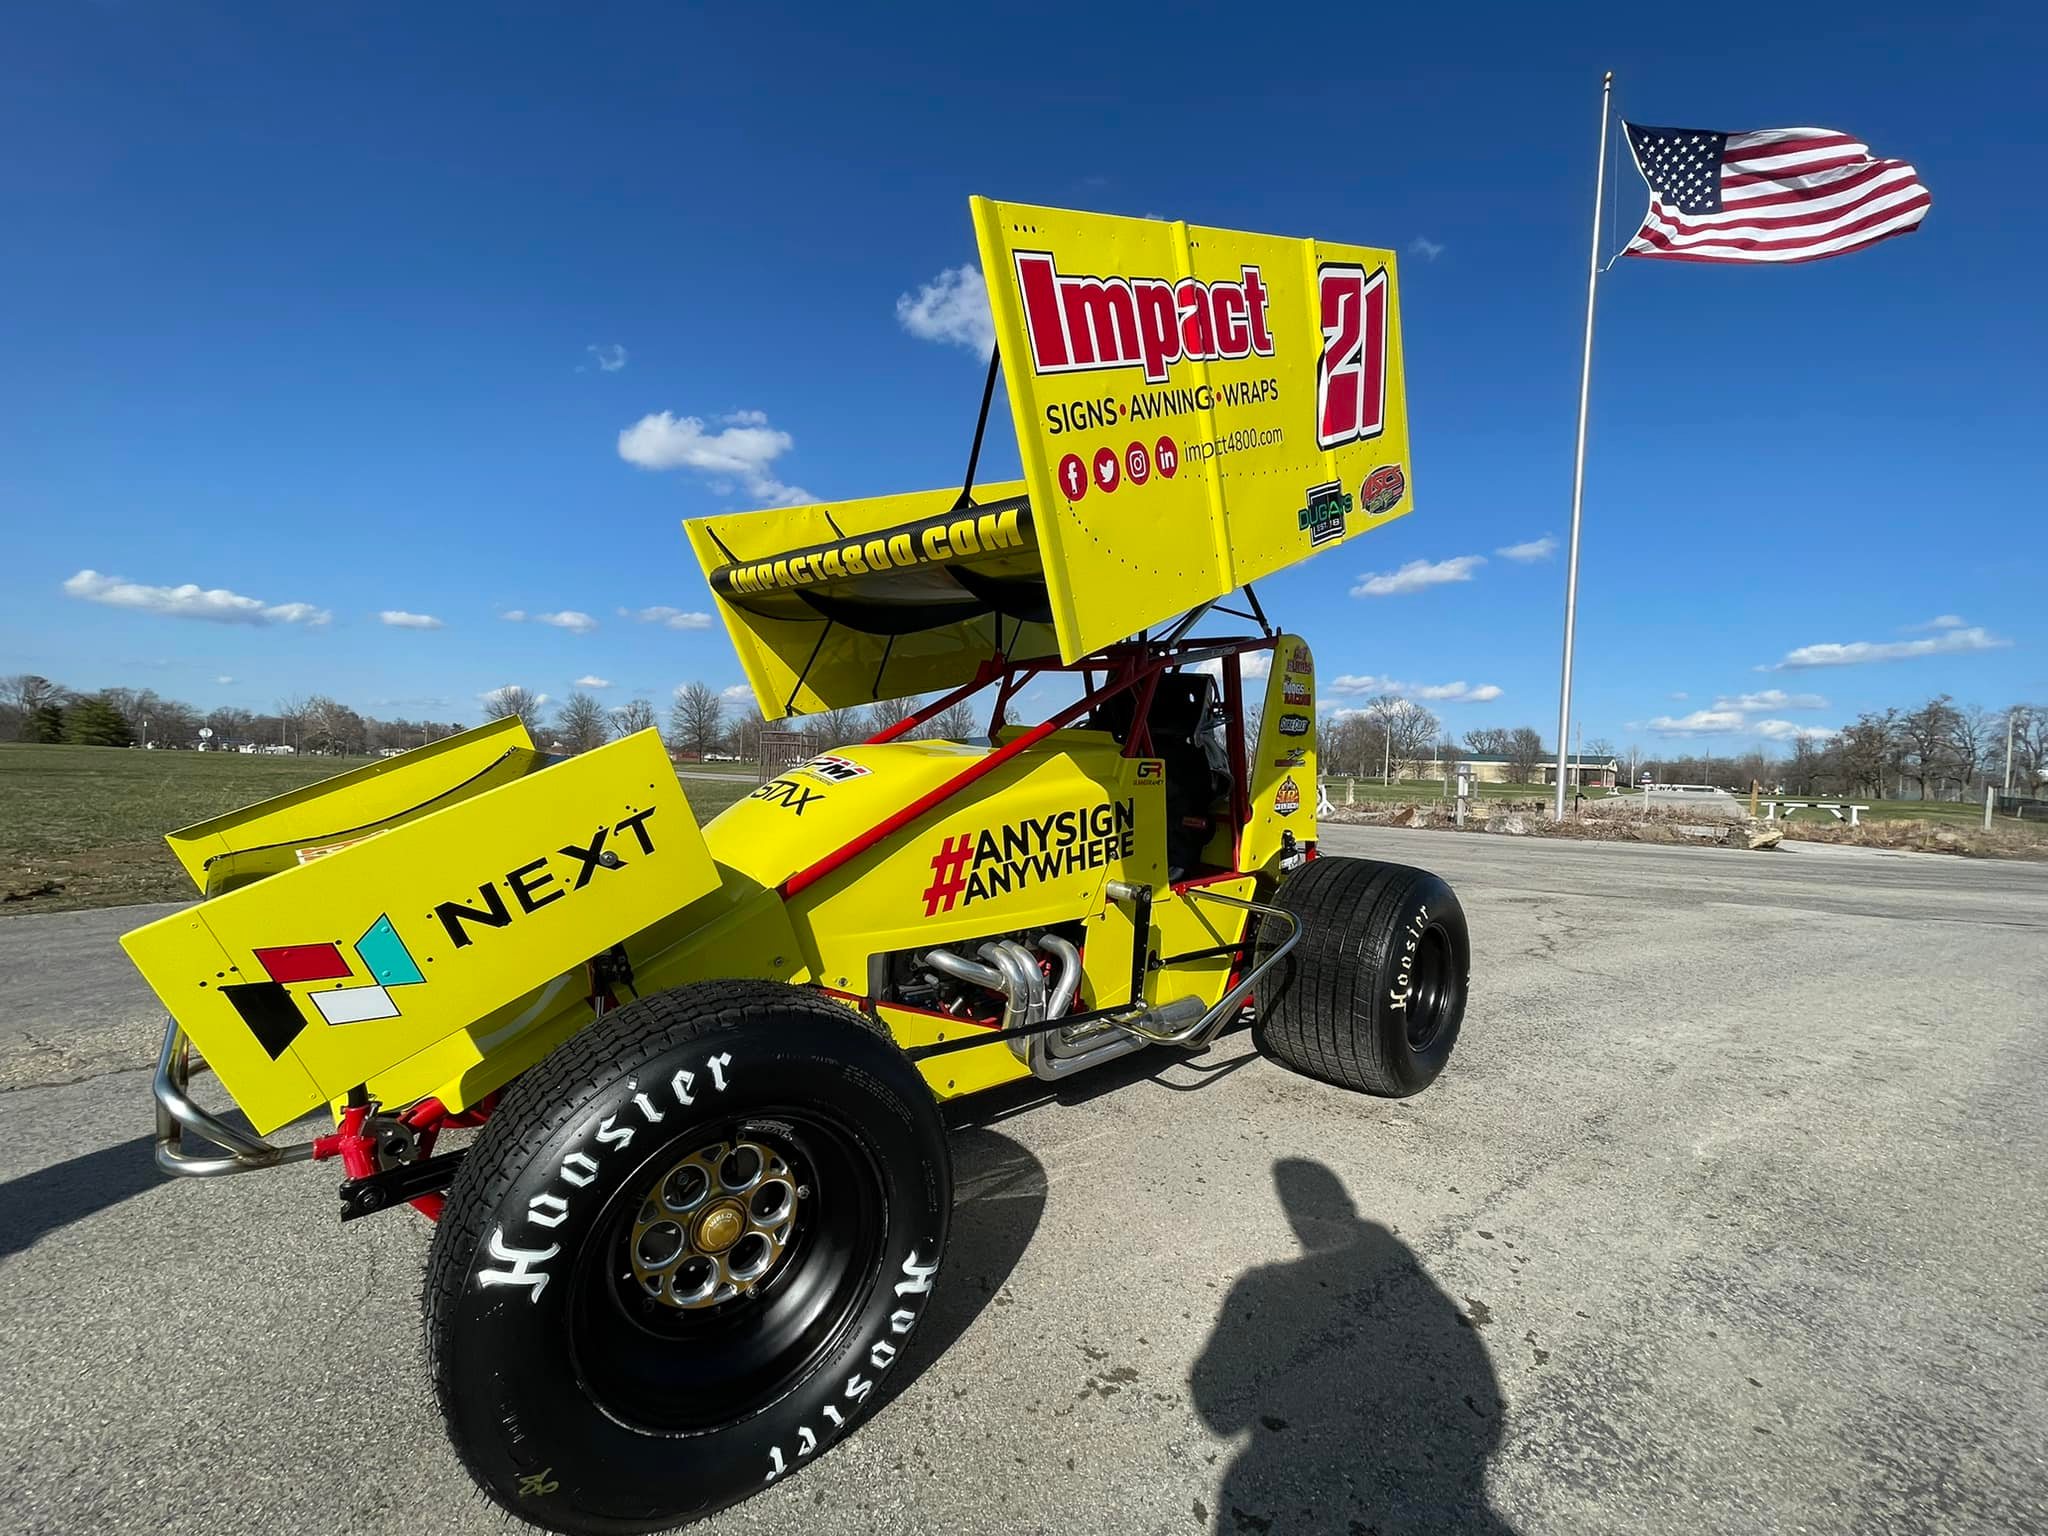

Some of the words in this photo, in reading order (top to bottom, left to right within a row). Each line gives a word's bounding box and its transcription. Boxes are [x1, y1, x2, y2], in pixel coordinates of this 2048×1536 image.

[1012, 249, 1276, 384] Impact
[1316, 261, 1389, 452] 21
[1046, 398, 1118, 435] SIGNS
[1222, 378, 1279, 407] WRAPS
[1184, 428, 1283, 464] impct4800.com
[729, 509, 1024, 594] IMPACT4800.COM
[1298, 492, 1353, 531] DUGAS
[434, 805, 657, 949] NEXT
[963, 829, 1135, 906] ANYWHERE
[1390, 904, 1428, 1013] Hoosier
[479, 1052, 733, 1304] Hoosier
[765, 1250, 940, 1481] Hoosier
